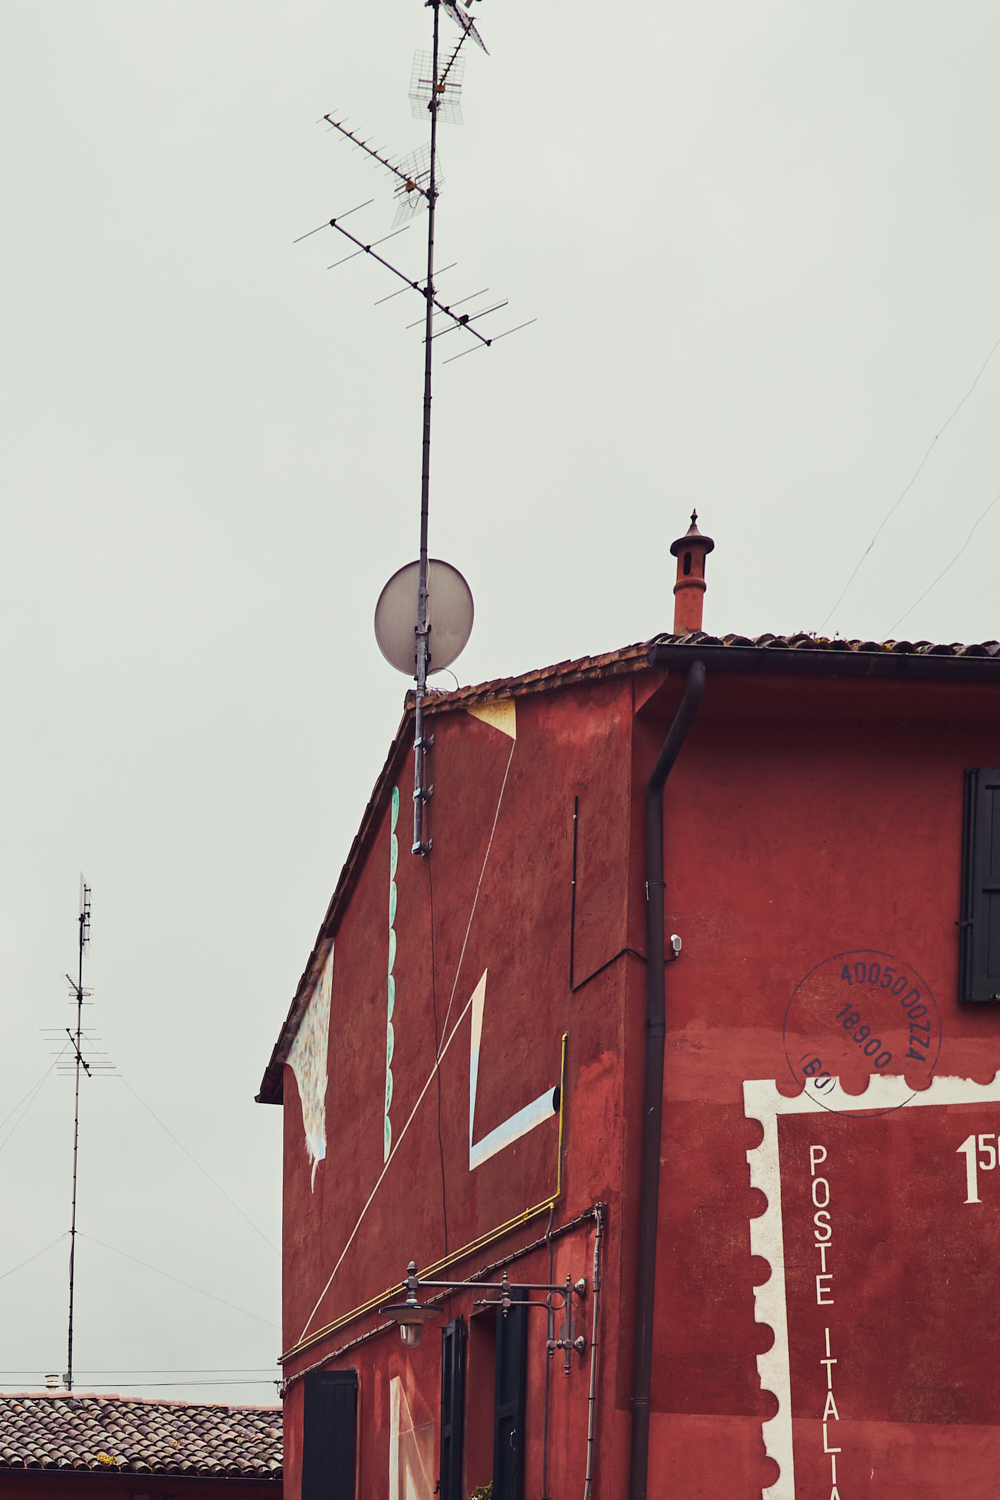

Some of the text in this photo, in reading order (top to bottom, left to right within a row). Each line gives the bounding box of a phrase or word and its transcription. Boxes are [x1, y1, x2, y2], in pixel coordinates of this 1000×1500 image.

[800, 1053, 837, 1096] (BO)
[955, 1133, 1000, 1204] 15
[809, 1144, 835, 1305] POSTE
